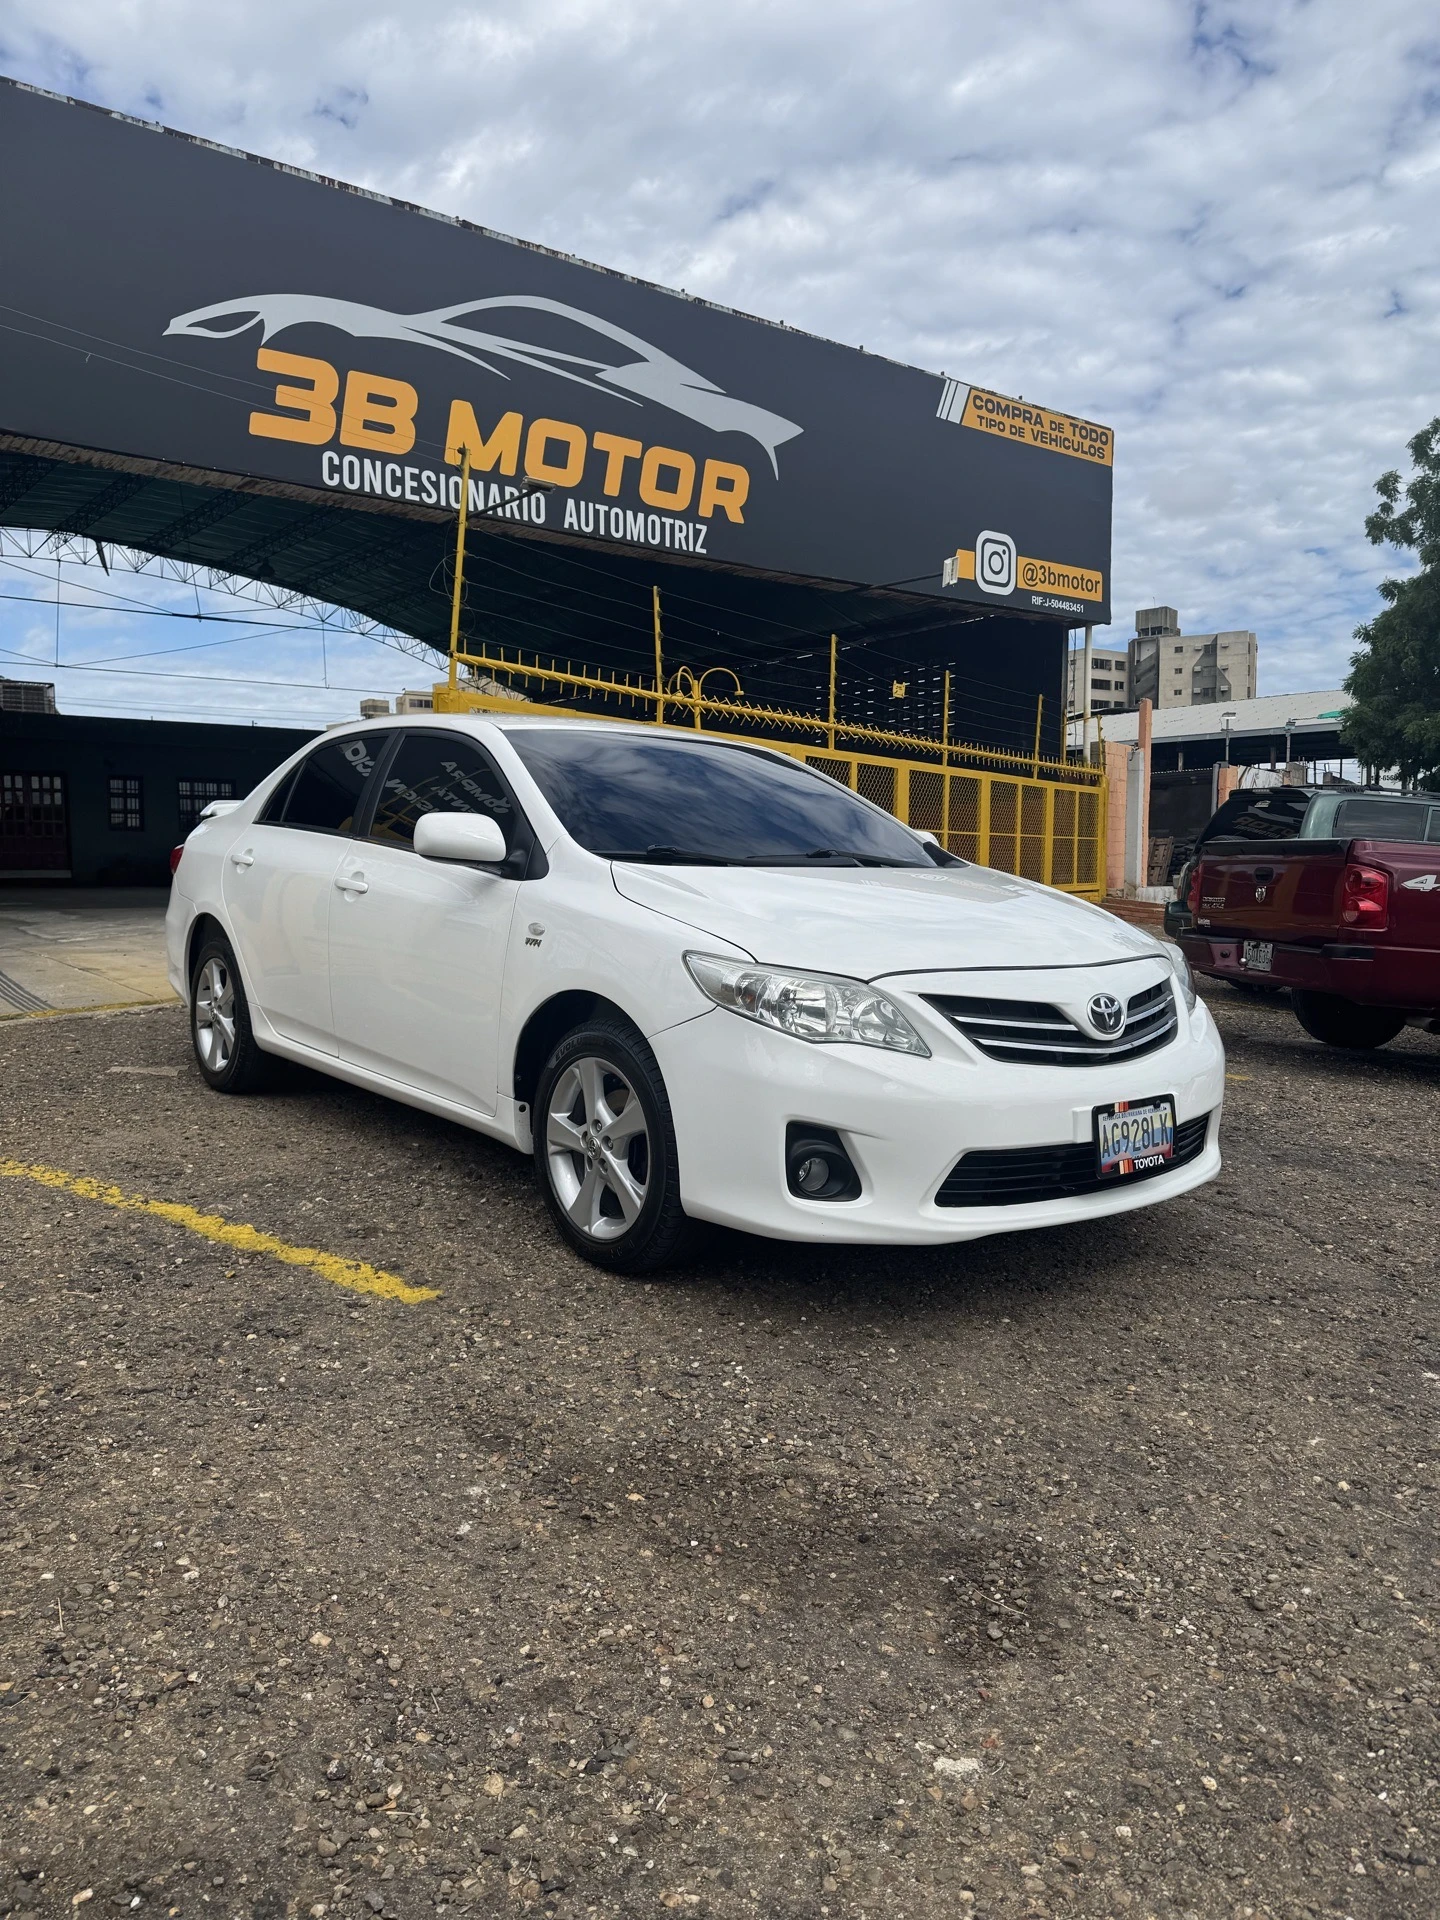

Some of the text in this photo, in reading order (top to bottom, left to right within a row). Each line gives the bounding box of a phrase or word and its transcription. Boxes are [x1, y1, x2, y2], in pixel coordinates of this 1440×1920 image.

[248, 347, 750, 524] 3B MOTOR
[972, 394, 1109, 446] COMPRA DE TODO
[976, 414, 1105, 460] TIPO DE VEHICULOS
[322, 451, 708, 554] CONCESIONARIO AUTOMOTRIZ
[1022, 562, 1100, 594] @3bmotor
[1401, 874, 1440, 892] 4
[1102, 1113, 1170, 1158] AG928LK
[1134, 1155, 1164, 1169] TOYOTA
